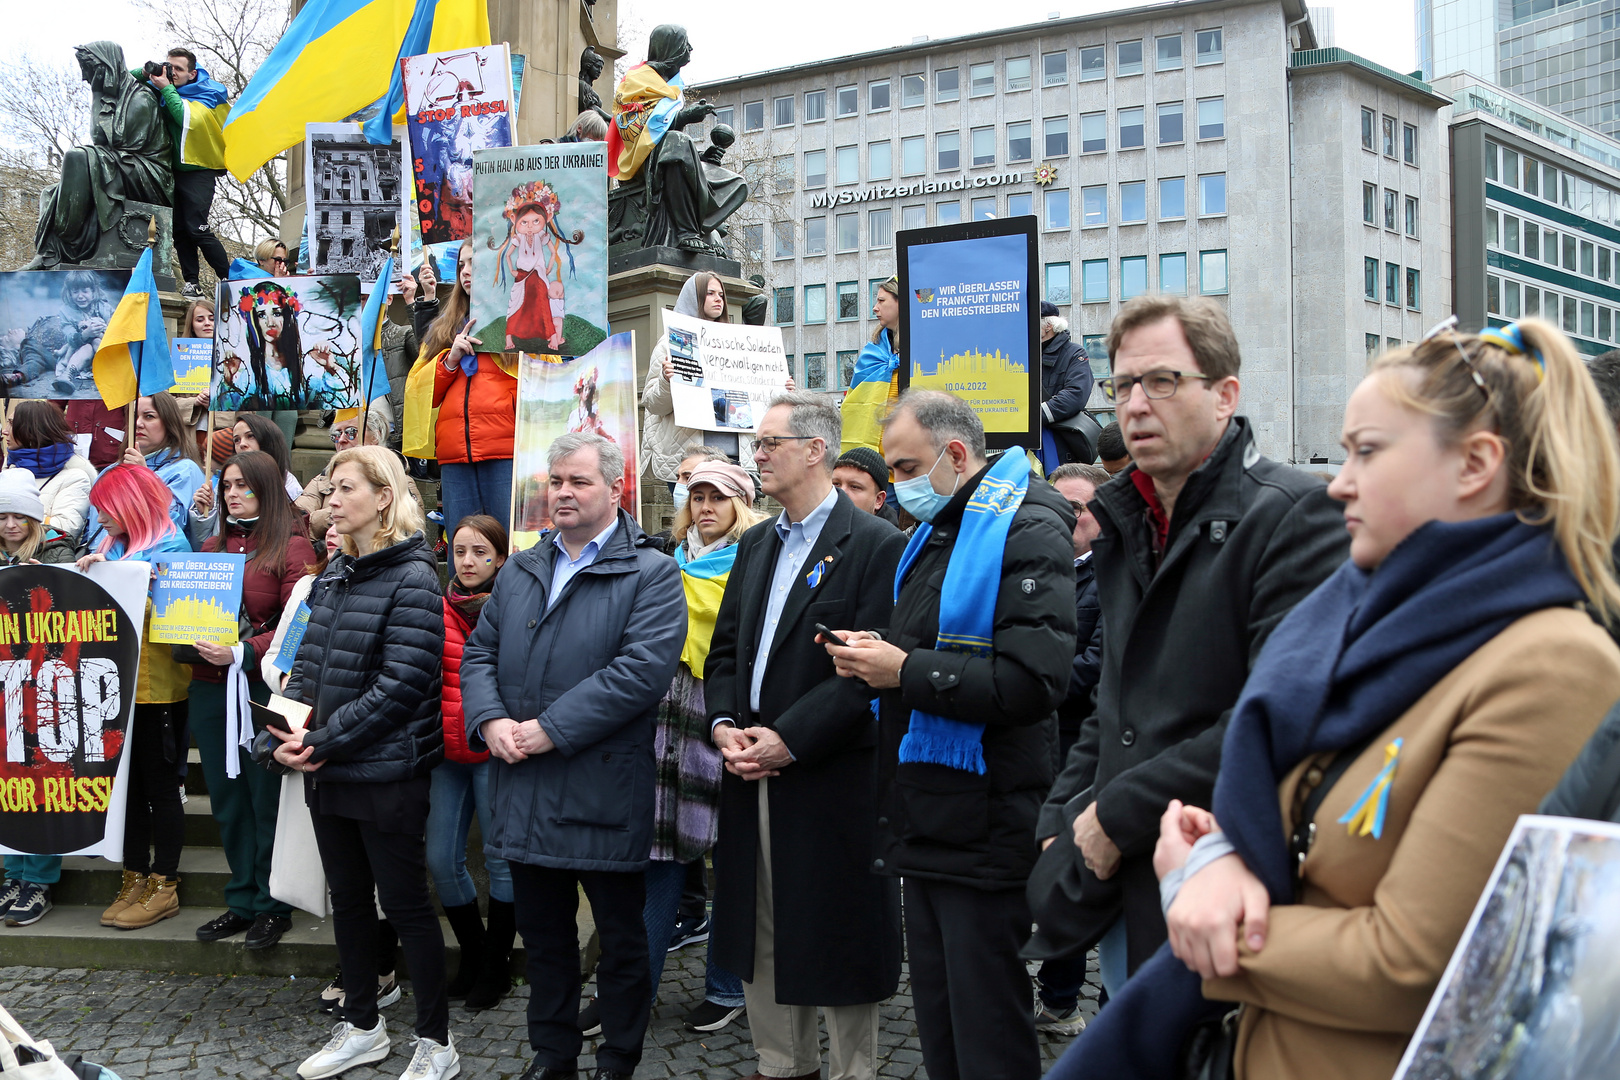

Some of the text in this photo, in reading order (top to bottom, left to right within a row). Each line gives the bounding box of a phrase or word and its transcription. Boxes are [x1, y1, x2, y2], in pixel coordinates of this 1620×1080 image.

[1047, 76, 1066, 84] Klinik
[418, 107, 456, 124] STOP
[476, 154, 603, 175] PUTIN HAU AB AUS DER UKRAINE!
[810, 171, 1022, 209] MySwitzerland.com
[939, 280, 1020, 296] WIR ÜBERLASSEN
[936, 292, 1020, 307] FRANKFURT NICHT
[921, 303, 1020, 318] DEN KRIEGSTREIBERN
[700, 326, 781, 354] Russische Soldaten
[703, 354, 764, 374] vergewaltigen
[766, 363, 784, 372] nicht
[945, 381, 987, 391] 10.04.2022
[172, 560, 234, 571] WIR ÜBERLASSEN
[168, 571, 234, 580] FRANKFURT NICHT
[171, 581, 232, 590] KRIEGSTREIBERN
[0, 608, 118, 644] IN UKRAINE!
[43, 776, 116, 812] RUSSI
